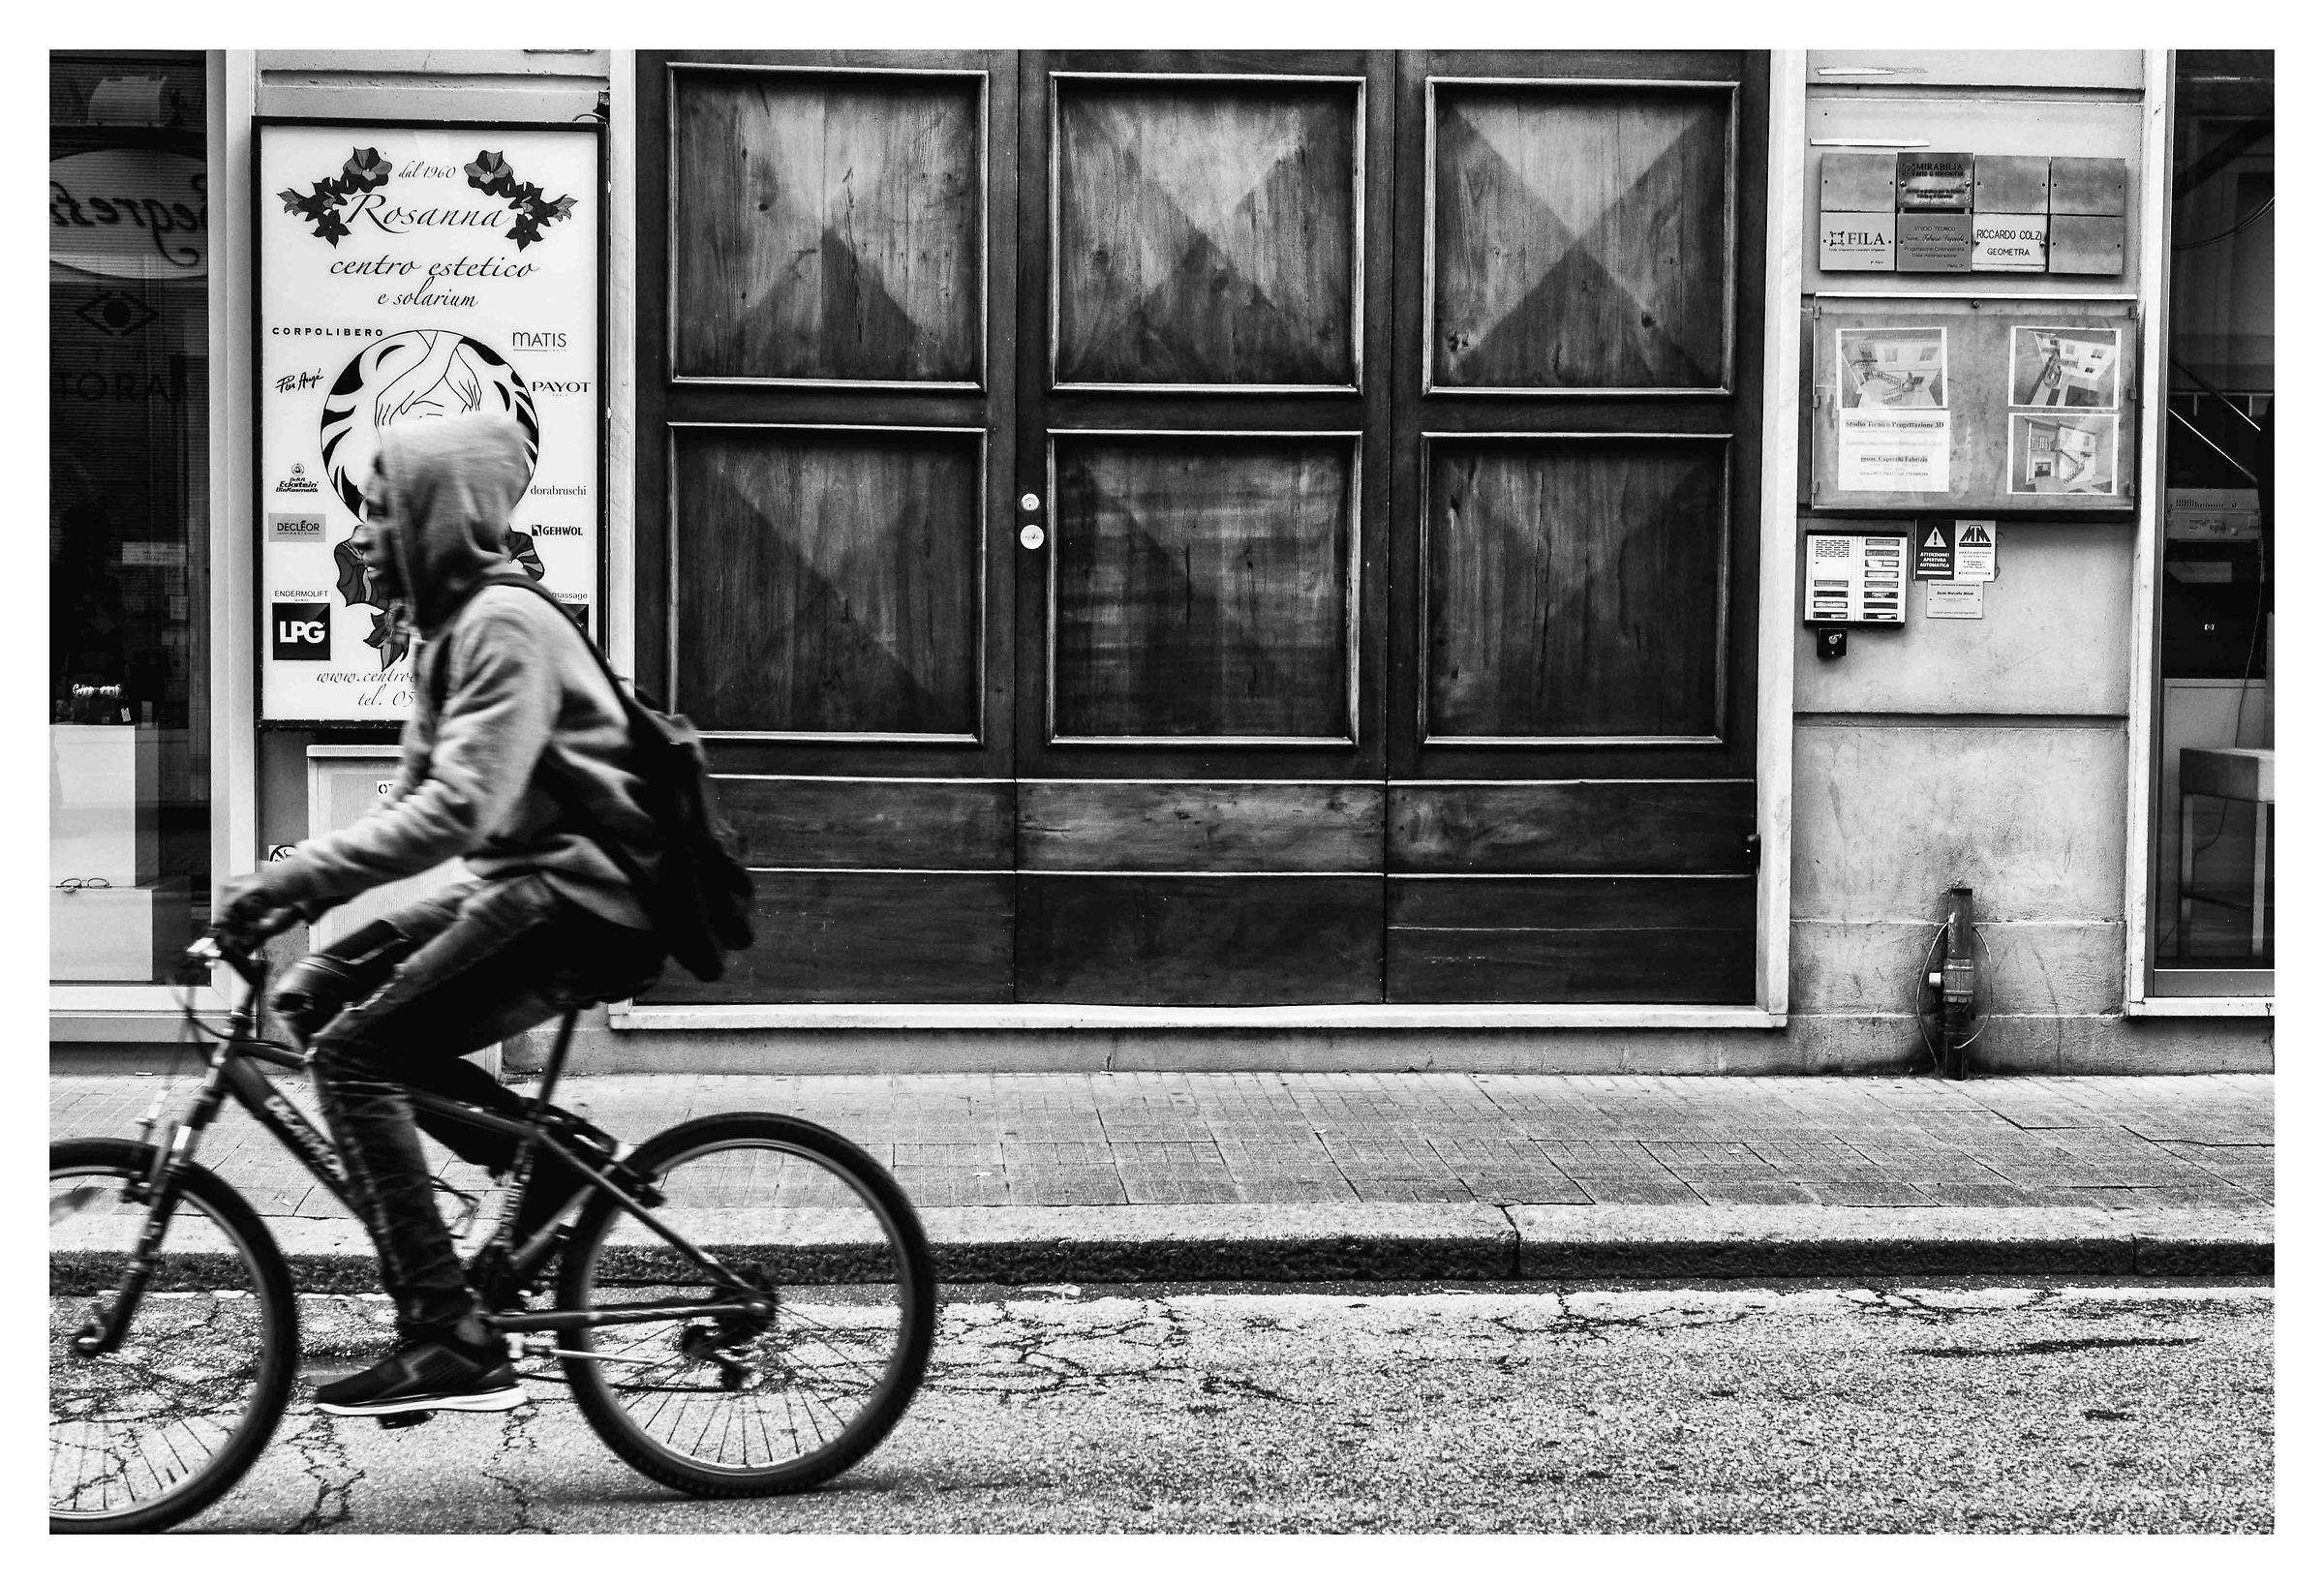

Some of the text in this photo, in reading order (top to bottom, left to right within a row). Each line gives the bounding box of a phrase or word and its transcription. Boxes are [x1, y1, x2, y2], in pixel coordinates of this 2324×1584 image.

[398, 161, 456, 179] dal 1960
[345, 194, 511, 233] Rosanna
[1848, 232, 1885, 245] FILA
[1976, 229, 2043, 241] RICCARDO COLZI
[1986, 248, 2031, 257] GEOMETRA
[329, 255, 539, 278] centro estetico
[378, 276, 478, 307] e solarium
[272, 327, 383, 337] CORPOLIBERO
[532, 381, 592, 393] PAYOT
[1846, 419, 1866, 428] Studio
[530, 484, 587, 497] dorabruschi
[542, 526, 584, 536] GEHWOL
[279, 621, 325, 644] LPG
[358, 684, 387, 706] tel.
